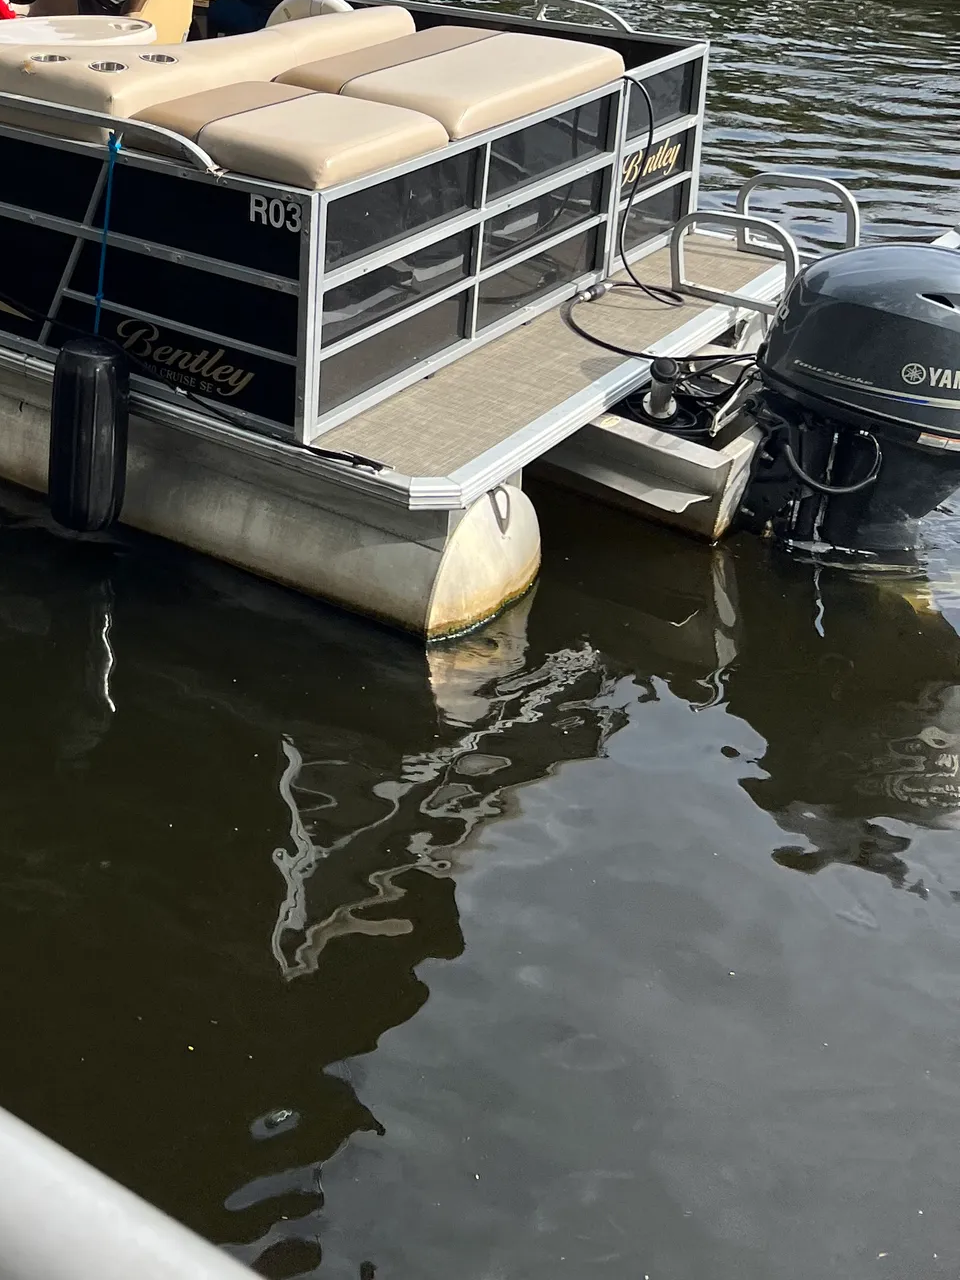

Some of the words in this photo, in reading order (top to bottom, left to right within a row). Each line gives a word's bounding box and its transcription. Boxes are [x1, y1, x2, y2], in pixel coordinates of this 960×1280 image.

[621, 137, 681, 188] Bntley
[249, 192, 302, 233] R03
[116, 319, 256, 396] Bentley
[159, 368, 197, 388] CRUISE
[199, 380, 214, 393] SE
